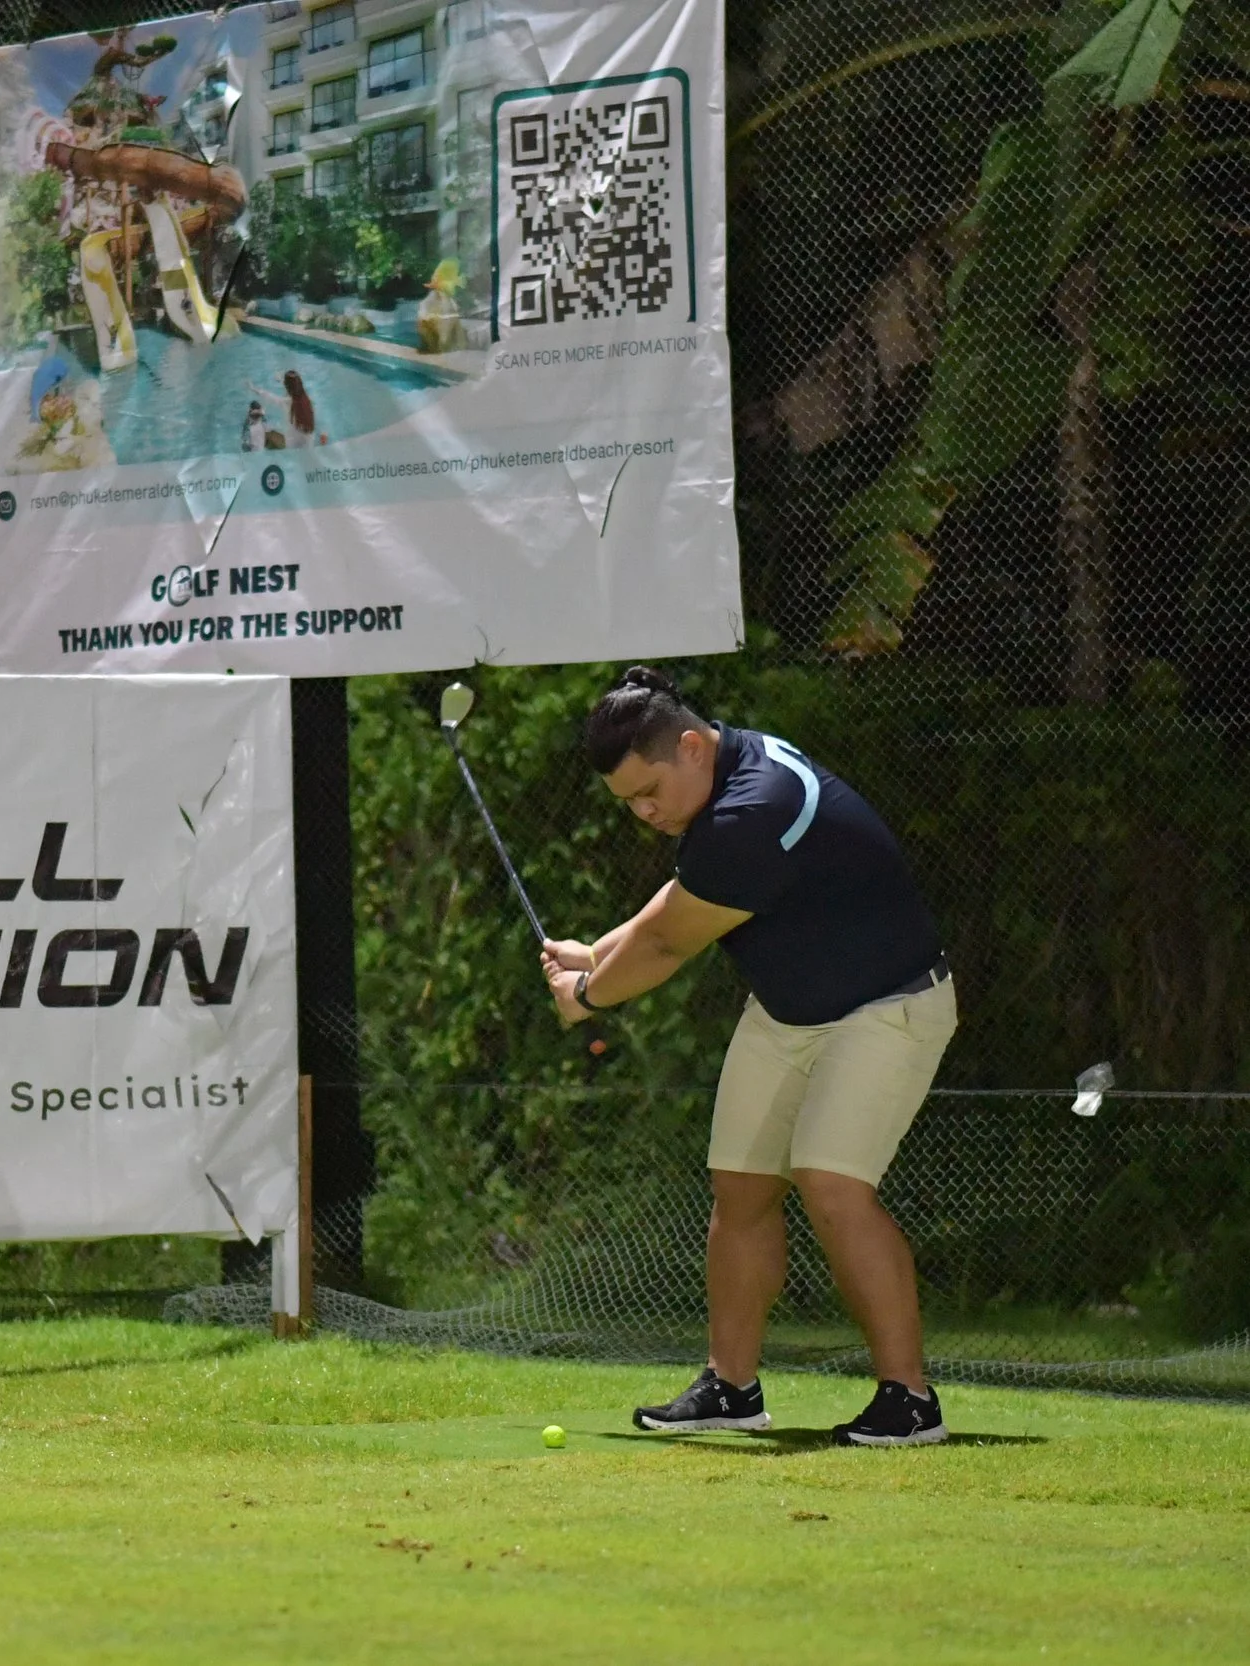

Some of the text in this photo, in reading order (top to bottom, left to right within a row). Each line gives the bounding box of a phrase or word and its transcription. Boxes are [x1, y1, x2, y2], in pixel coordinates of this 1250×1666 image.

[495, 336, 698, 371] SCAN FOR MORE INFOMATION
[305, 438, 675, 483] whitesandbluesea.com/phuketemeraldbeachresort
[151, 564, 300, 607] GOLF NEST
[58, 605, 404, 653] THANK YOU FOR THE SUPPORT
[9, 1073, 250, 1121] Specialist
